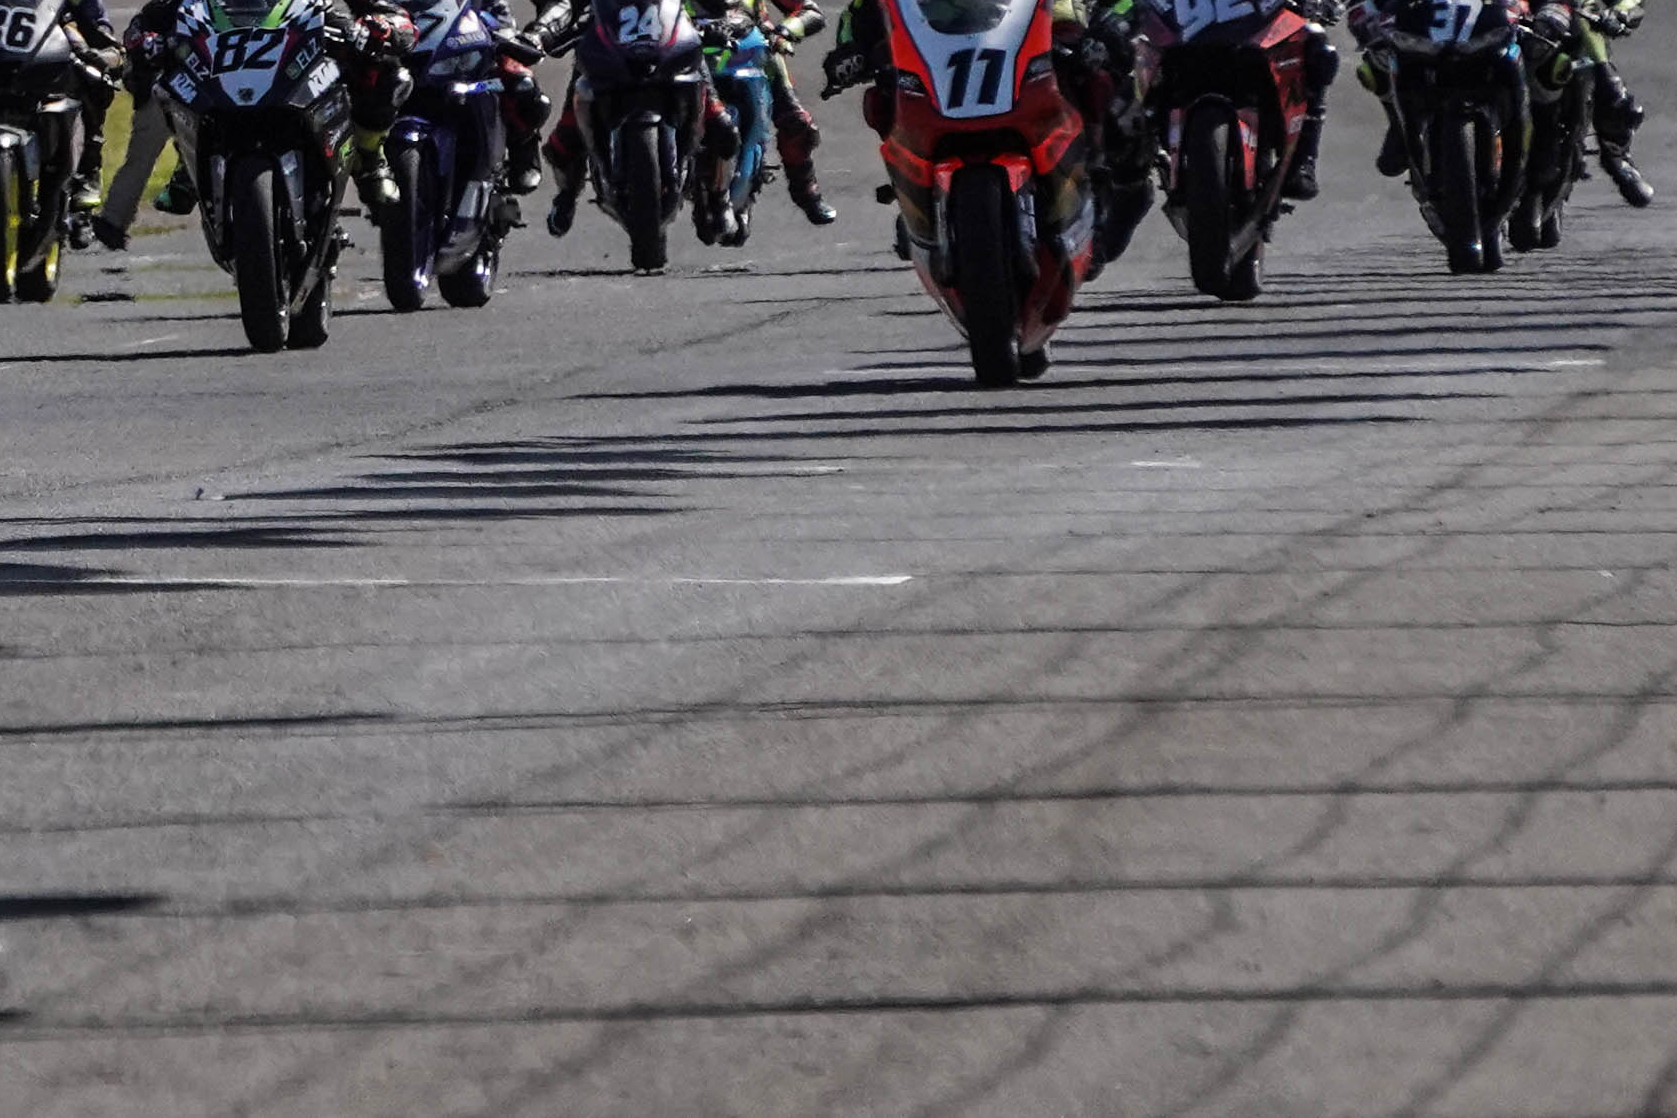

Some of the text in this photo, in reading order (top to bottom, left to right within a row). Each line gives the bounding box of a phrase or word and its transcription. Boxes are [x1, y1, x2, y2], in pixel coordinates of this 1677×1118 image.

[618, 5, 661, 43] 24
[213, 28, 287, 75] 82
[947, 48, 1007, 109] 11
